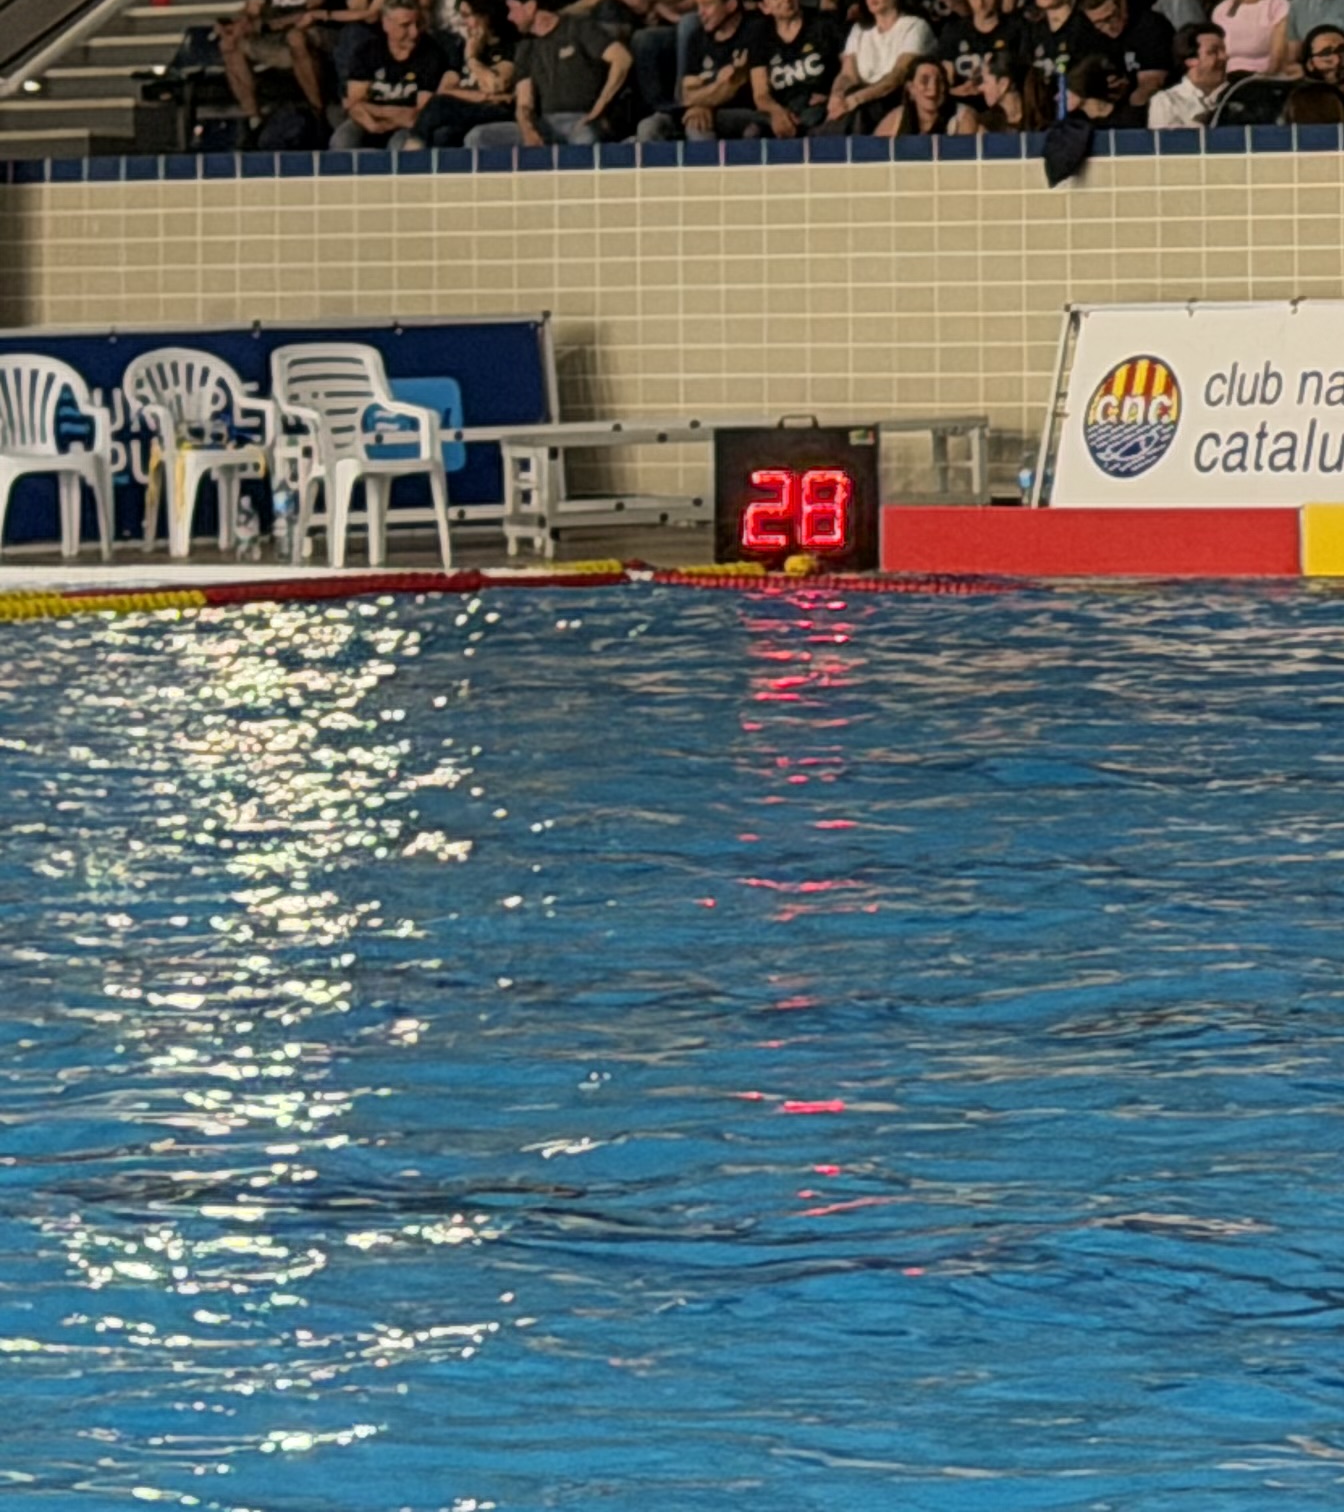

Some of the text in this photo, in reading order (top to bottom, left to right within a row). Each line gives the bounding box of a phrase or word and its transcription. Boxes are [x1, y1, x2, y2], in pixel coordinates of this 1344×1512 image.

[769, 52, 826, 90] CNC
[1204, 361, 1283, 407] club
[1098, 392, 1173, 426] cnc
[742, 468, 850, 548] 28
